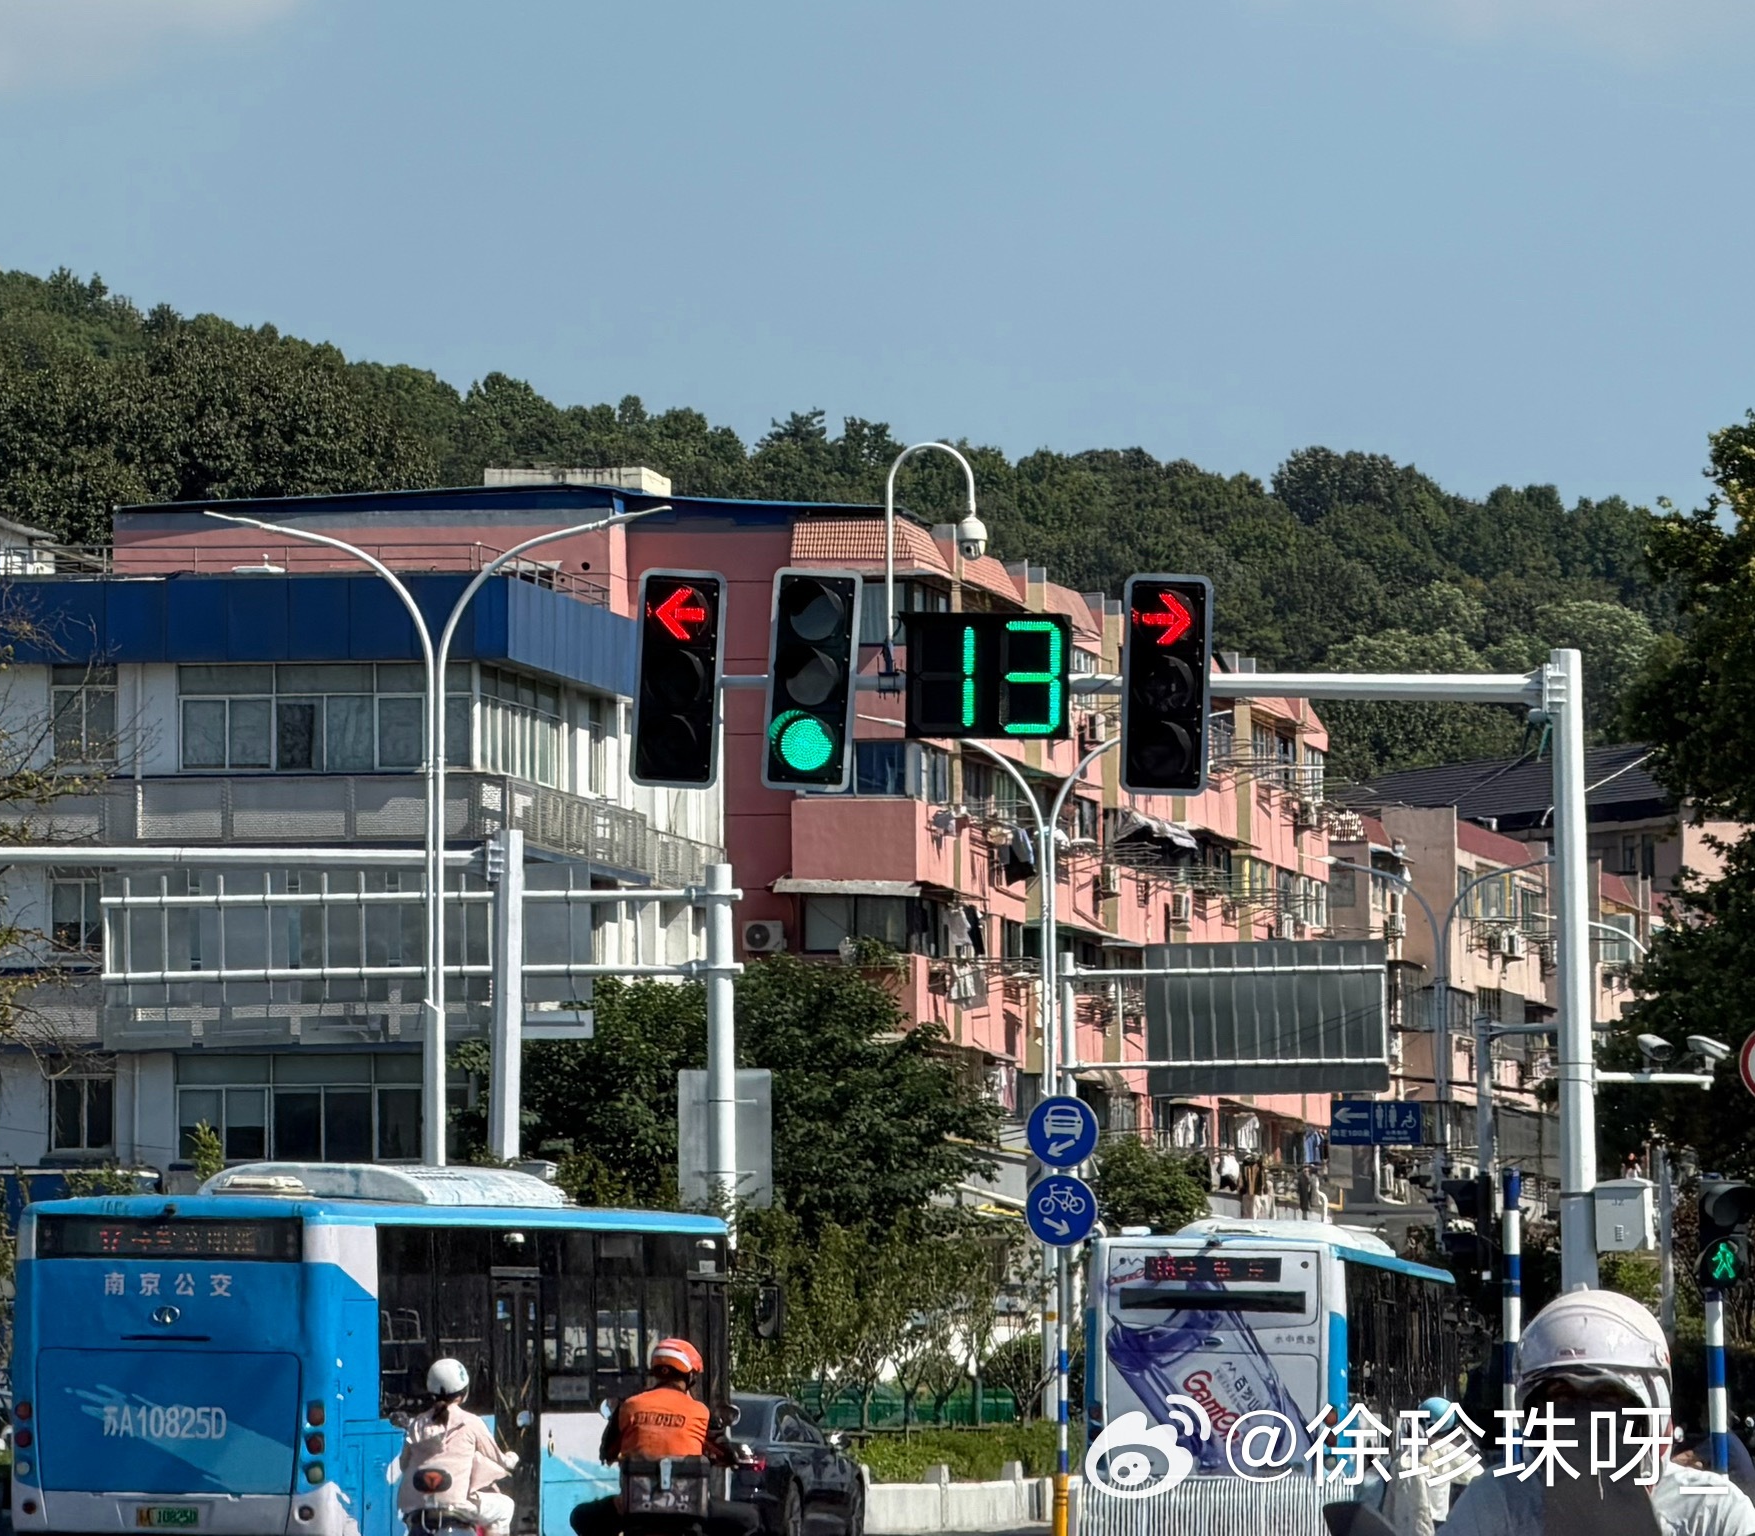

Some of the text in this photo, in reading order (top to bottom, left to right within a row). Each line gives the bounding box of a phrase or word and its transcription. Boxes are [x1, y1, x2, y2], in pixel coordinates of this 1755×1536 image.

[961, 619, 1063, 735] 13
[104, 1272, 233, 1297] 南京公交
[103, 1404, 227, 1439] 苏A10825D
